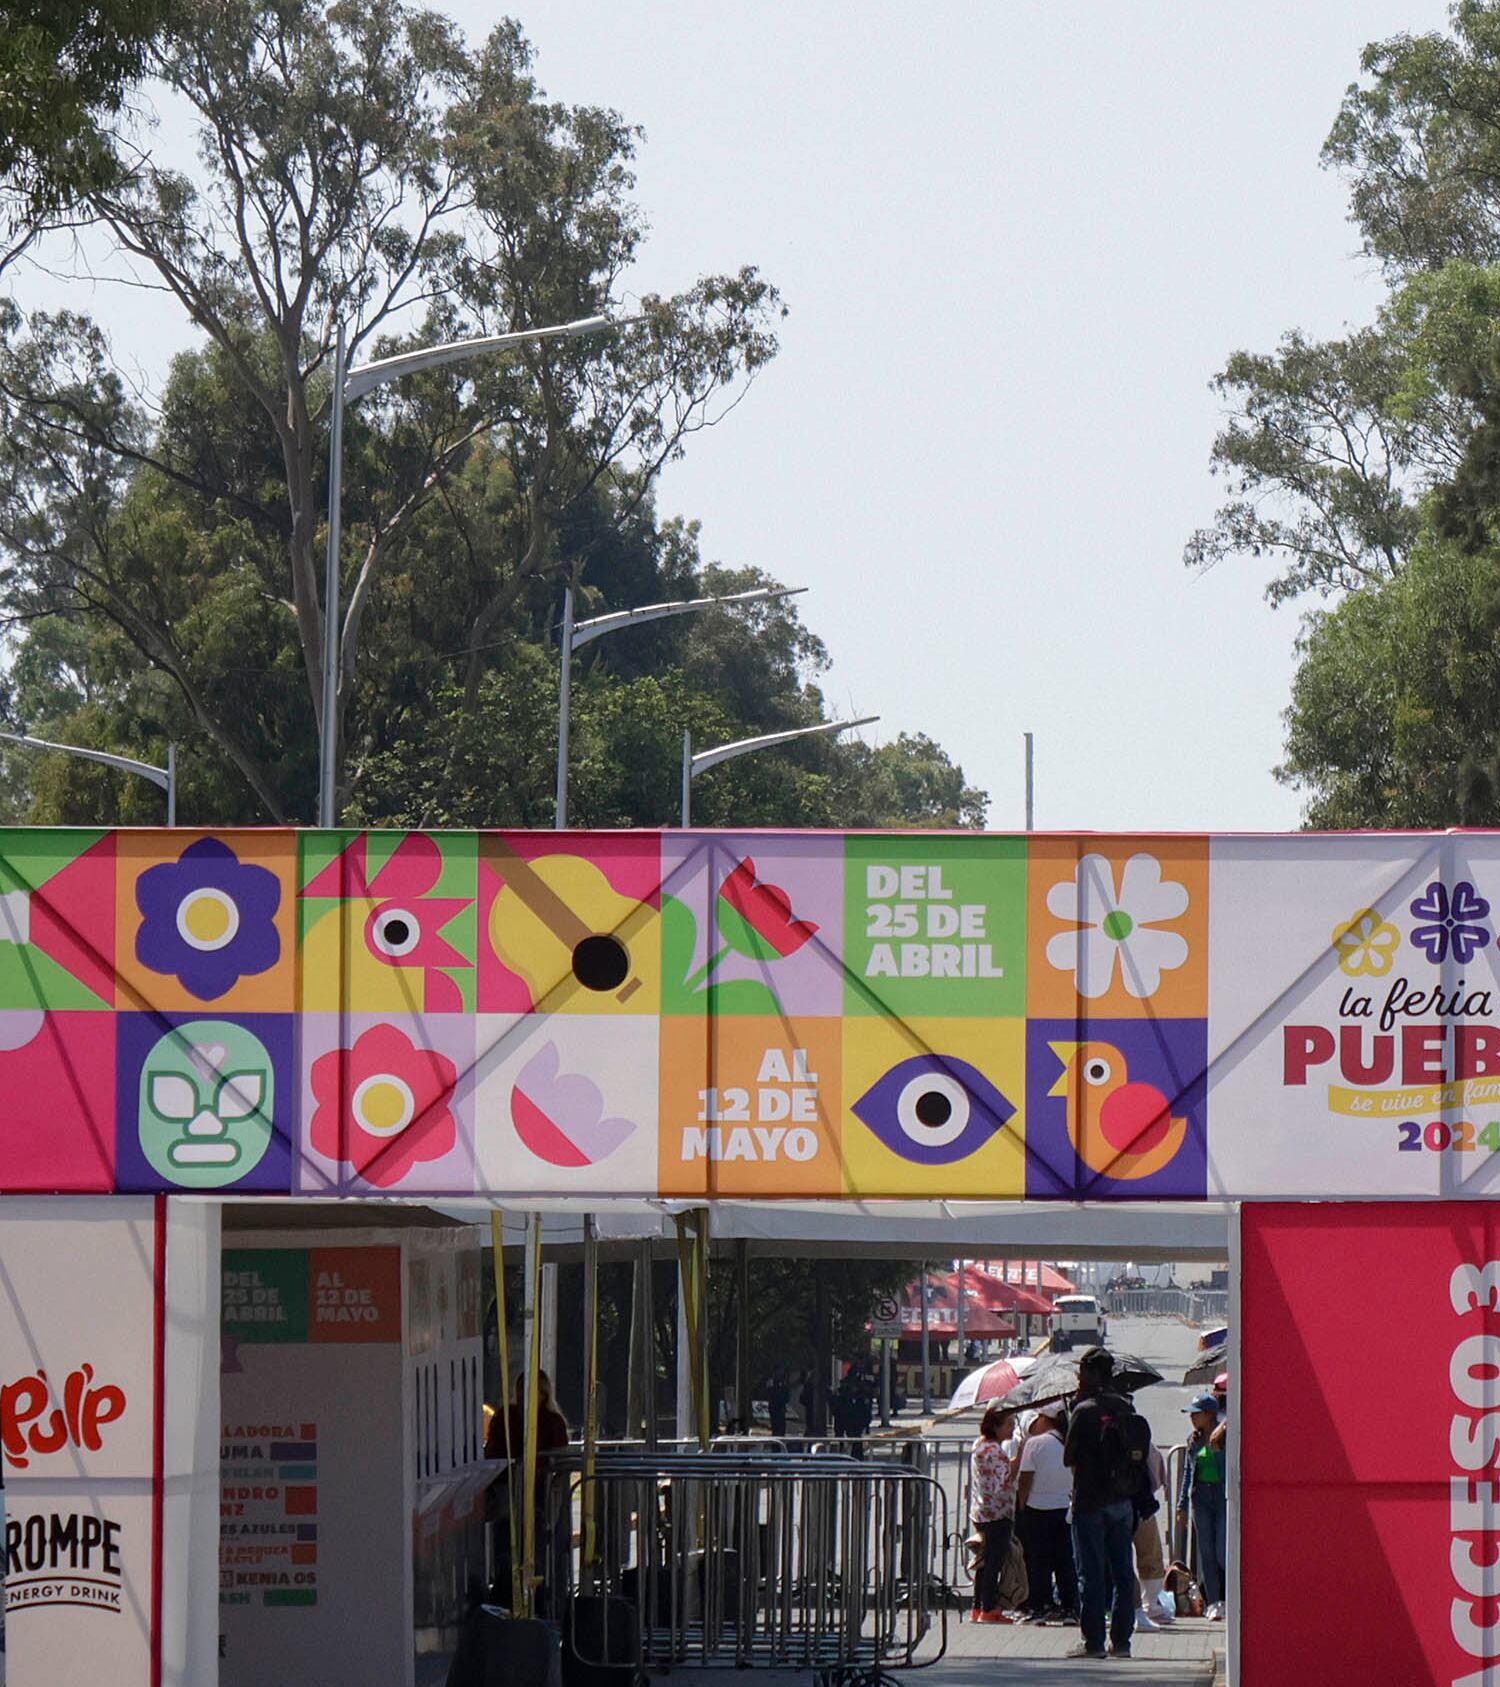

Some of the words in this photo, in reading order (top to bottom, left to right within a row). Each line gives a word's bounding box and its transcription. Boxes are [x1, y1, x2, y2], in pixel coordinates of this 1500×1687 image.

[866, 866, 953, 900] DEL
[865, 904, 921, 938] 25
[927, 905, 987, 938] DE
[865, 944, 1004, 978] ABRIL
[1338, 986, 1374, 1018] la
[1379, 977, 1494, 1032] feria
[757, 1048, 819, 1083] AL
[697, 1088, 751, 1121] 12
[758, 1088, 819, 1122] DE
[1350, 1096, 1374, 1112] se
[1380, 1092, 1425, 1113] vive
[1431, 1089, 1456, 1104] en
[681, 1127, 820, 1161] MAYO
[223, 1272, 264, 1287] DEL
[317, 1272, 344, 1287] AL
[223, 1289, 248, 1304] 25
[252, 1289, 280, 1304] DE
[316, 1290, 339, 1305] 12
[345, 1290, 372, 1305] DE
[223, 1306, 288, 1321] ABRIL
[316, 1306, 379, 1322] MAYO
[6, 1513, 122, 1576] ROMPE
[236, 1571, 291, 1586] KENIA
[294, 1571, 317, 1585] OS
[10, 1585, 64, 1604] NERGY
[71, 1586, 120, 1605] DRINK
